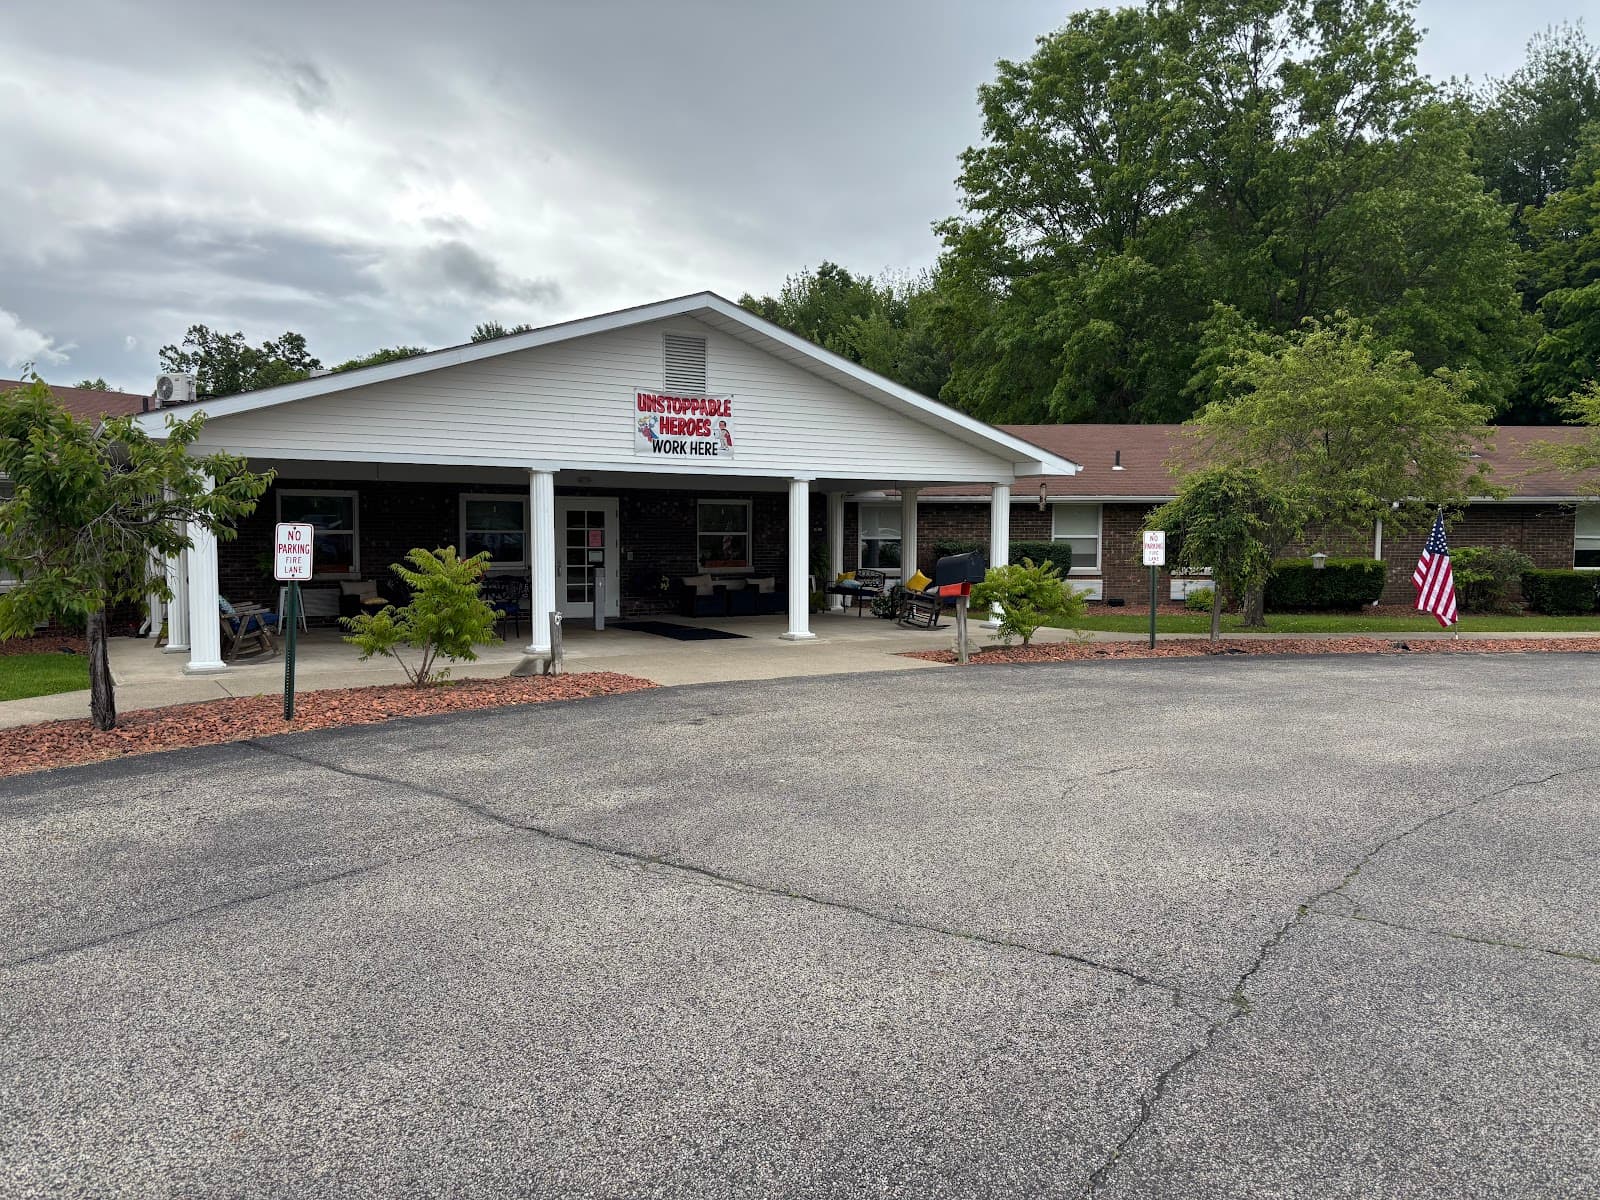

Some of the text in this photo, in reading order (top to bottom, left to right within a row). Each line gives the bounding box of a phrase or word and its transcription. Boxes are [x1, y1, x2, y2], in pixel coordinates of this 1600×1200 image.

[637, 393, 732, 417] UNSTOPPABLE
[659, 416, 711, 437] HEROES
[652, 439, 719, 456] WORK HERE
[287, 530, 301, 541] NO
[278, 543, 310, 554] PARKING
